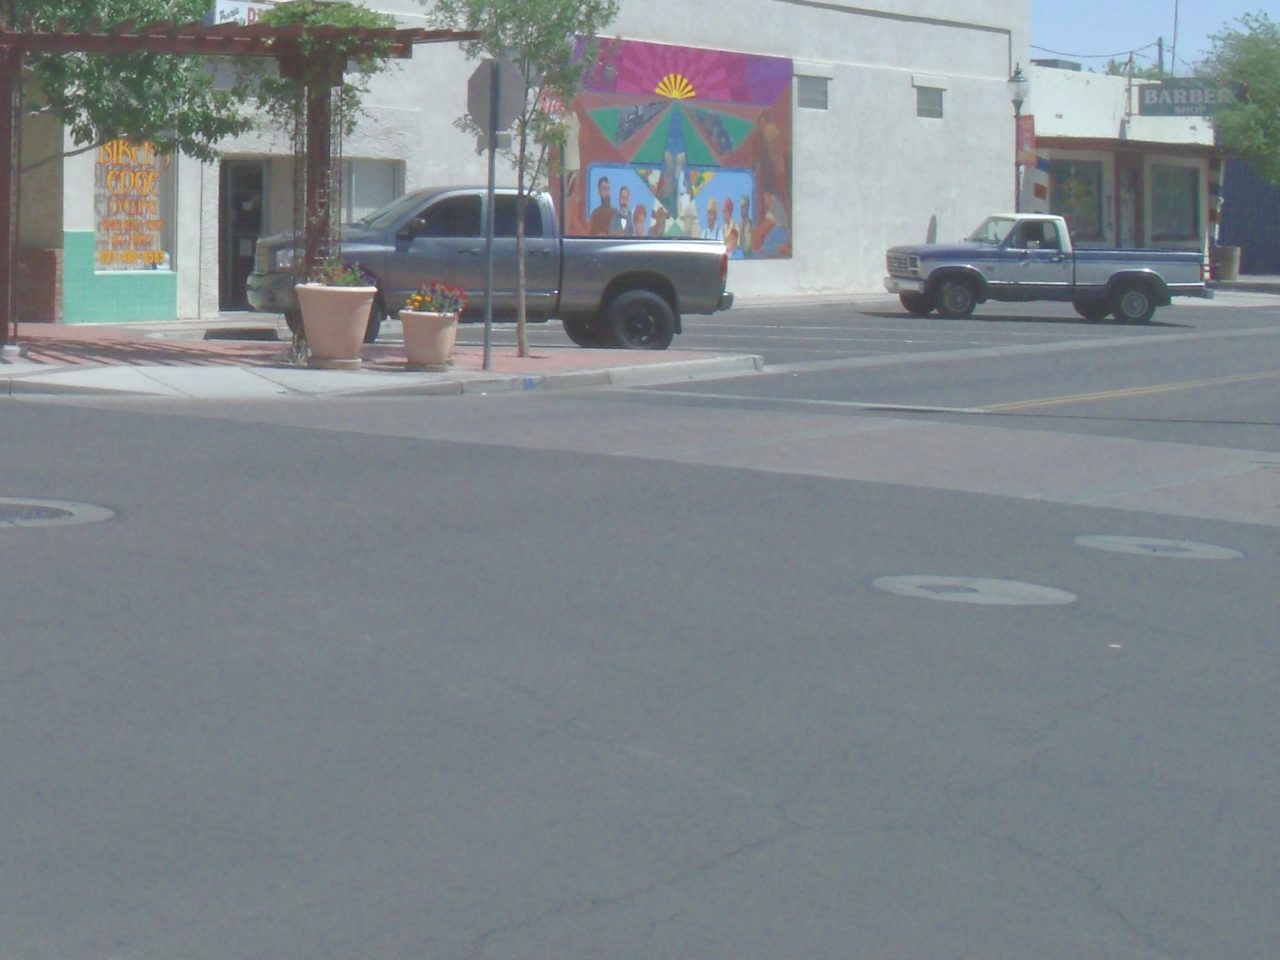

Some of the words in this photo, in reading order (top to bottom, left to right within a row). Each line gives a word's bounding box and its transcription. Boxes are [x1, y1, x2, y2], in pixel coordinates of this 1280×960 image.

[1143, 89, 1233, 105] BARBER
[1173, 105, 1208, 114] SHOP
[106, 170, 161, 196] EDGE
